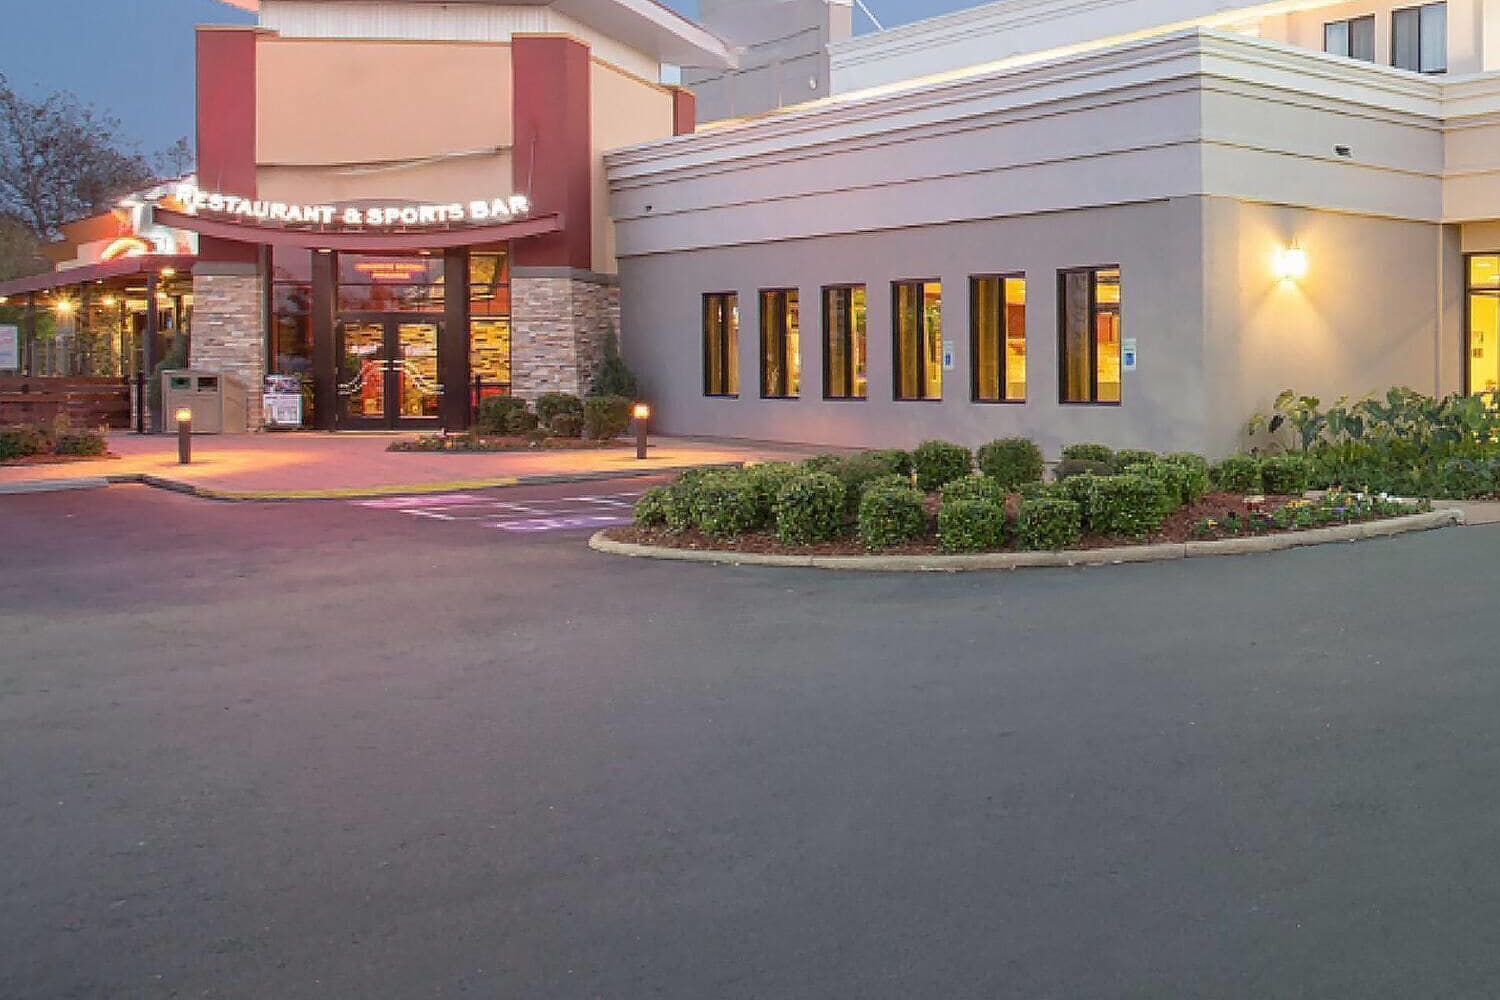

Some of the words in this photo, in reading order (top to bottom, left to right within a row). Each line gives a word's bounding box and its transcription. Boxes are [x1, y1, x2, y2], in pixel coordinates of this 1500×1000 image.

[343, 207, 362, 224] &
[366, 203, 464, 225] SPORTS
[469, 195, 529, 220] BAR
